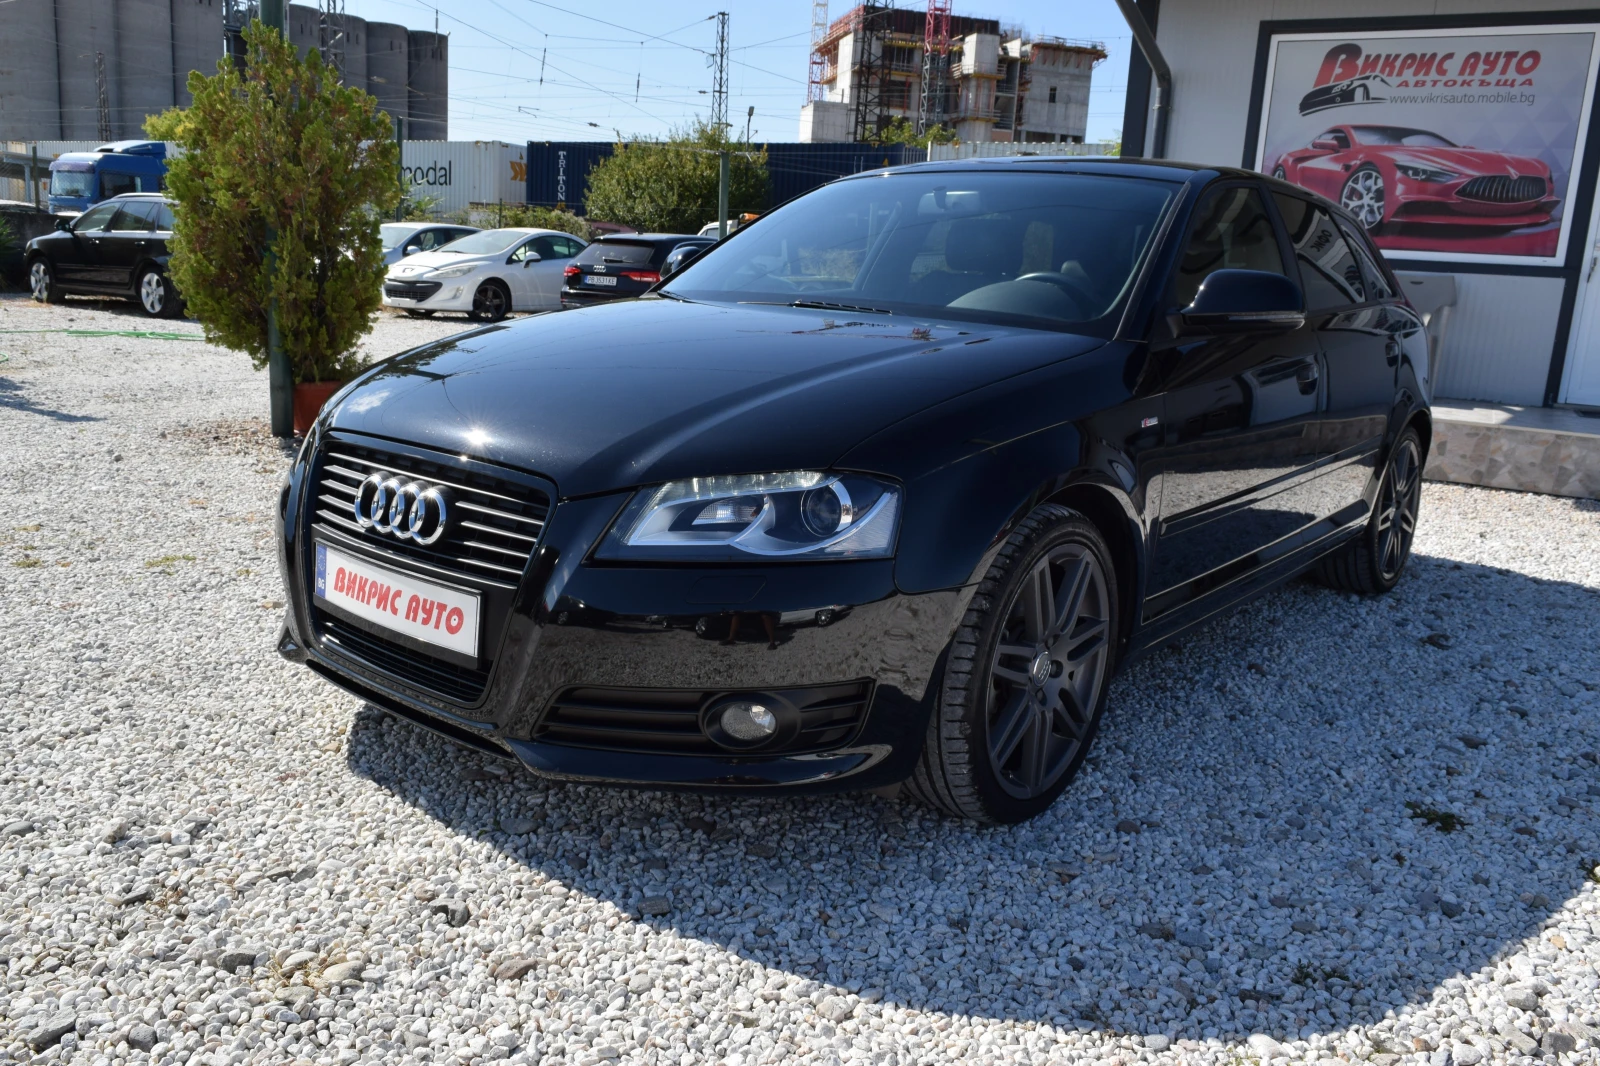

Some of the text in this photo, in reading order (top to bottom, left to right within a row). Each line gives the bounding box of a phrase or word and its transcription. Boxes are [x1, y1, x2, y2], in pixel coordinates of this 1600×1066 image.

[1459, 49, 1541, 77] АУТО
[1396, 78, 1534, 89] АВТОКЪЩА
[1389, 92, 1535, 106] www.vikrisauto.mobile.bg
[557, 152, 566, 201] TRITON
[318, 578, 325, 589] BG
[334, 567, 464, 635] ВИКРИС АУТО
